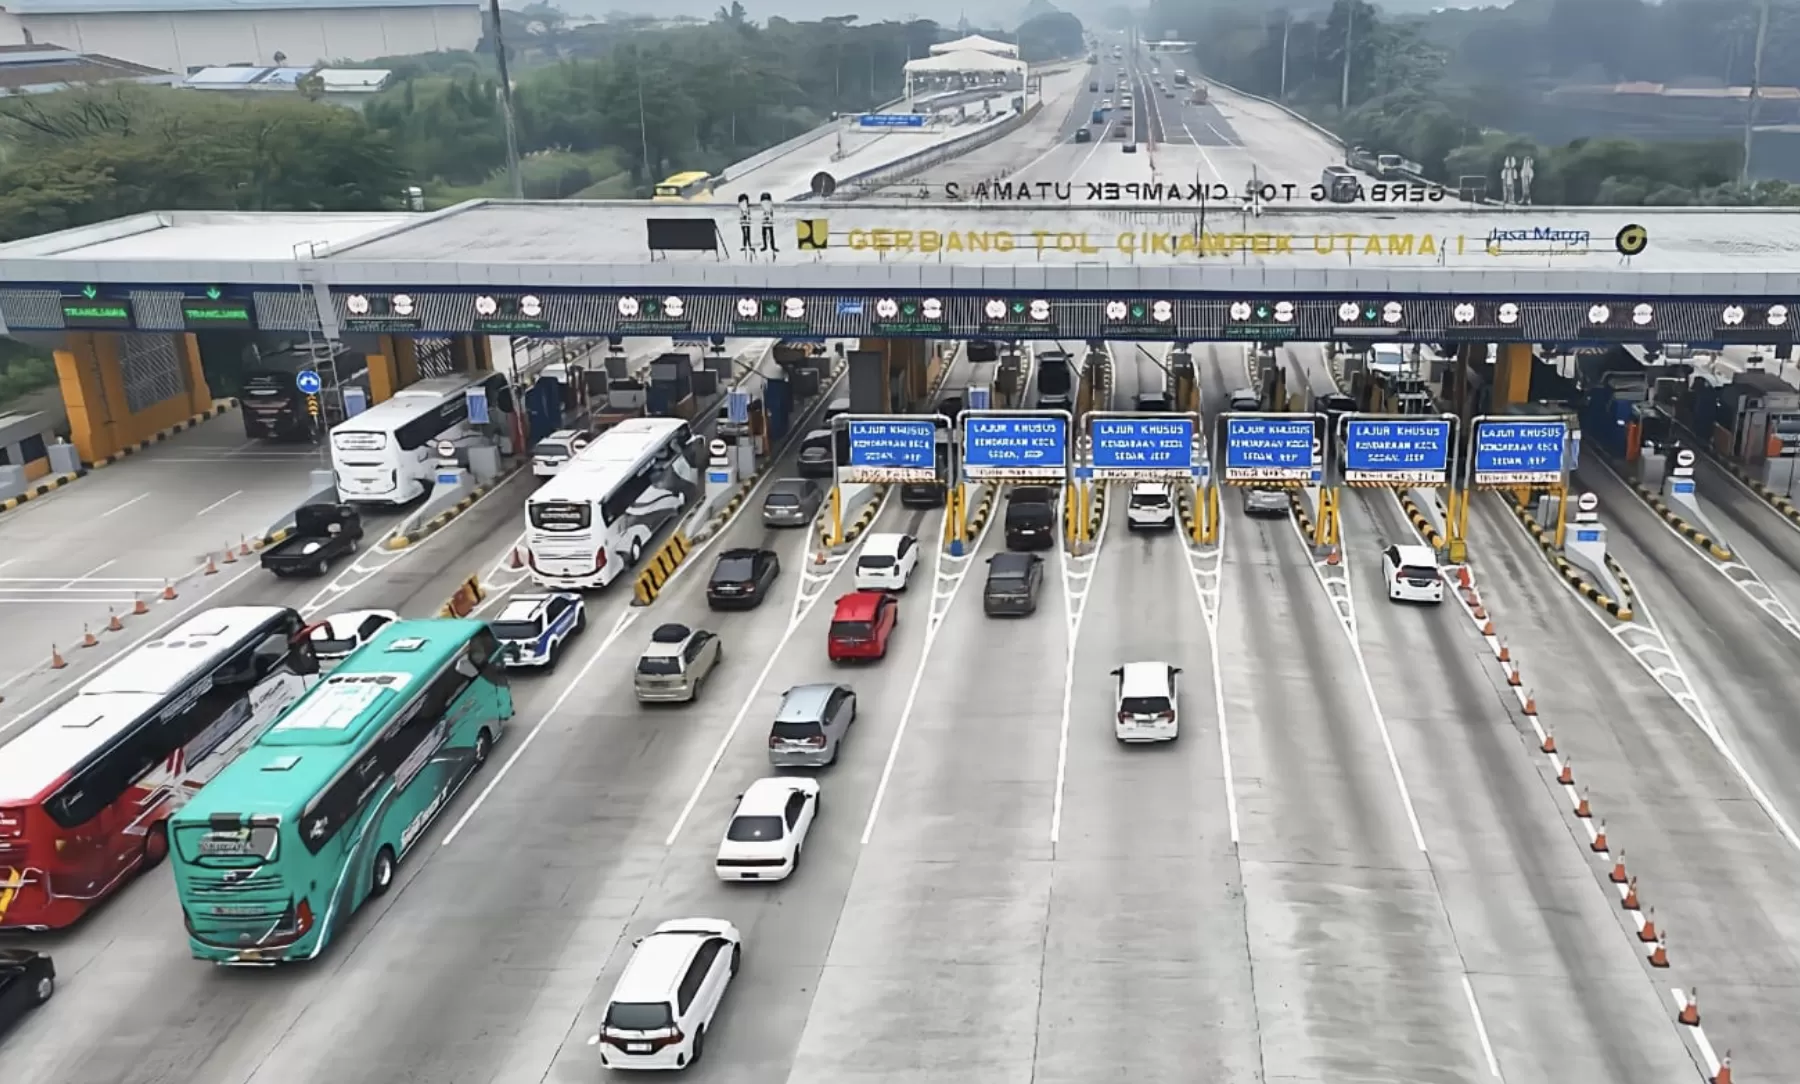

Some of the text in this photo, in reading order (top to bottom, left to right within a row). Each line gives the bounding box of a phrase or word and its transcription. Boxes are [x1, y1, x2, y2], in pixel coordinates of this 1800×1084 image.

[1533, 226, 1590, 246] Marga
[848, 229, 1013, 253] GERBANG
[1032, 231, 1099, 254] TOL
[1116, 232, 1292, 255] CIKAMPEK
[1313, 233, 1437, 256] UTAMA
[974, 424, 1006, 432] LAJUR
[1100, 425, 1183, 434] LAJUR KHUSUS
[1356, 426, 1440, 436] LAJUR KHUSUS
[1480, 427, 1560, 438] LAJUR KHUSUS
